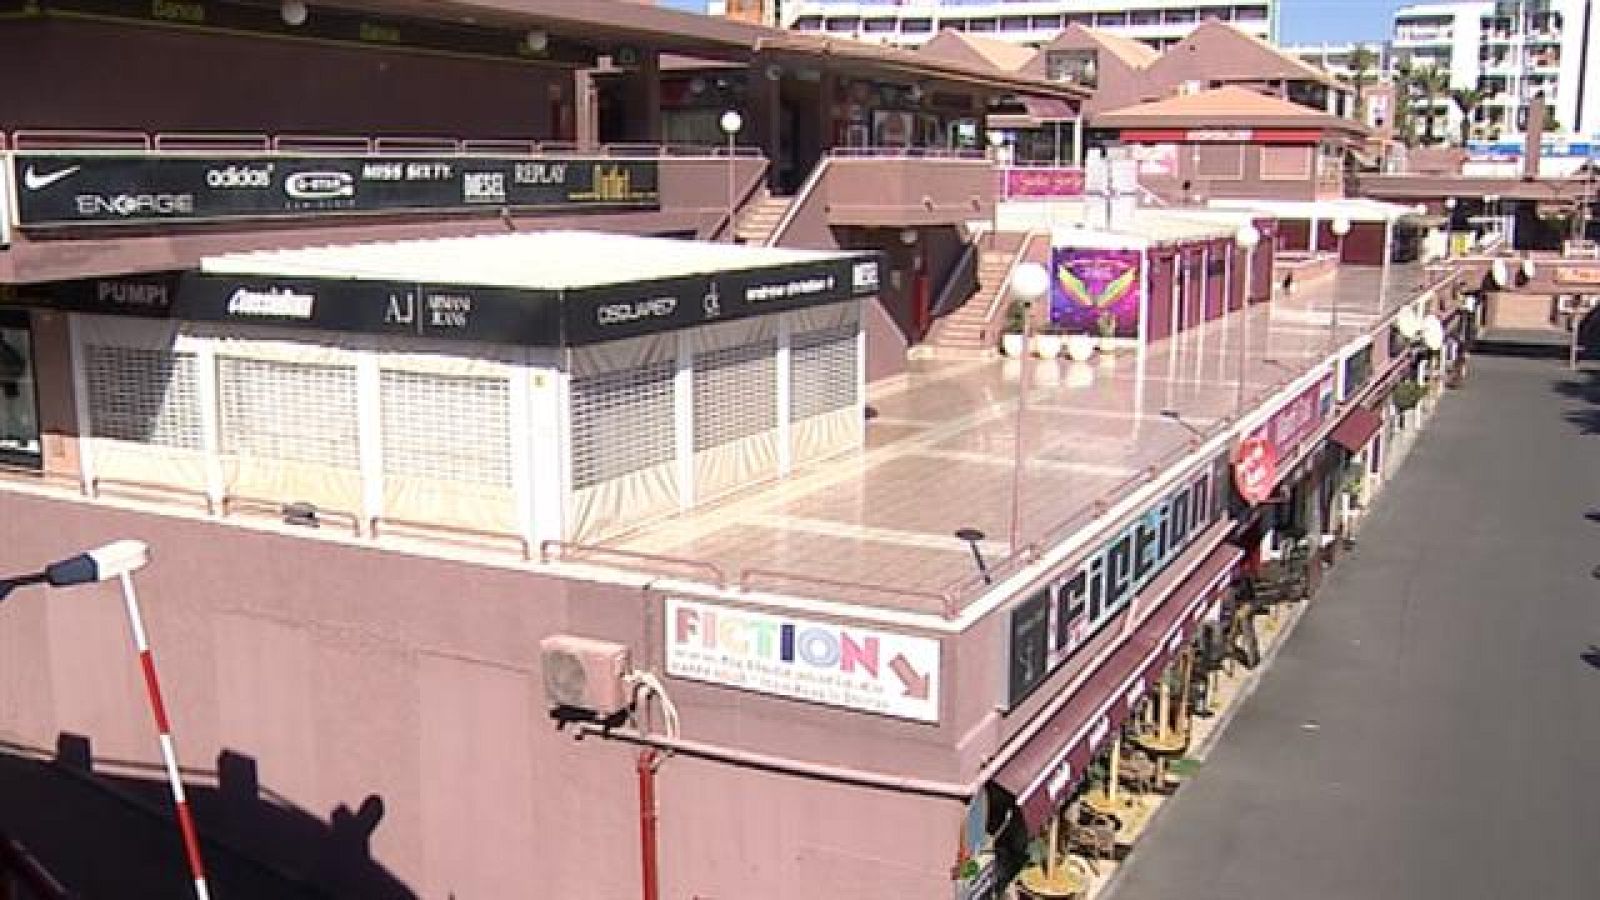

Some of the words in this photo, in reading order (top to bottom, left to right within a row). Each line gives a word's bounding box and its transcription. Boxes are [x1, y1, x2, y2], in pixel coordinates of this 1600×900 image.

[207, 165, 270, 187] adidas
[384, 292, 414, 323] AJ
[674, 606, 881, 679] FICTION
